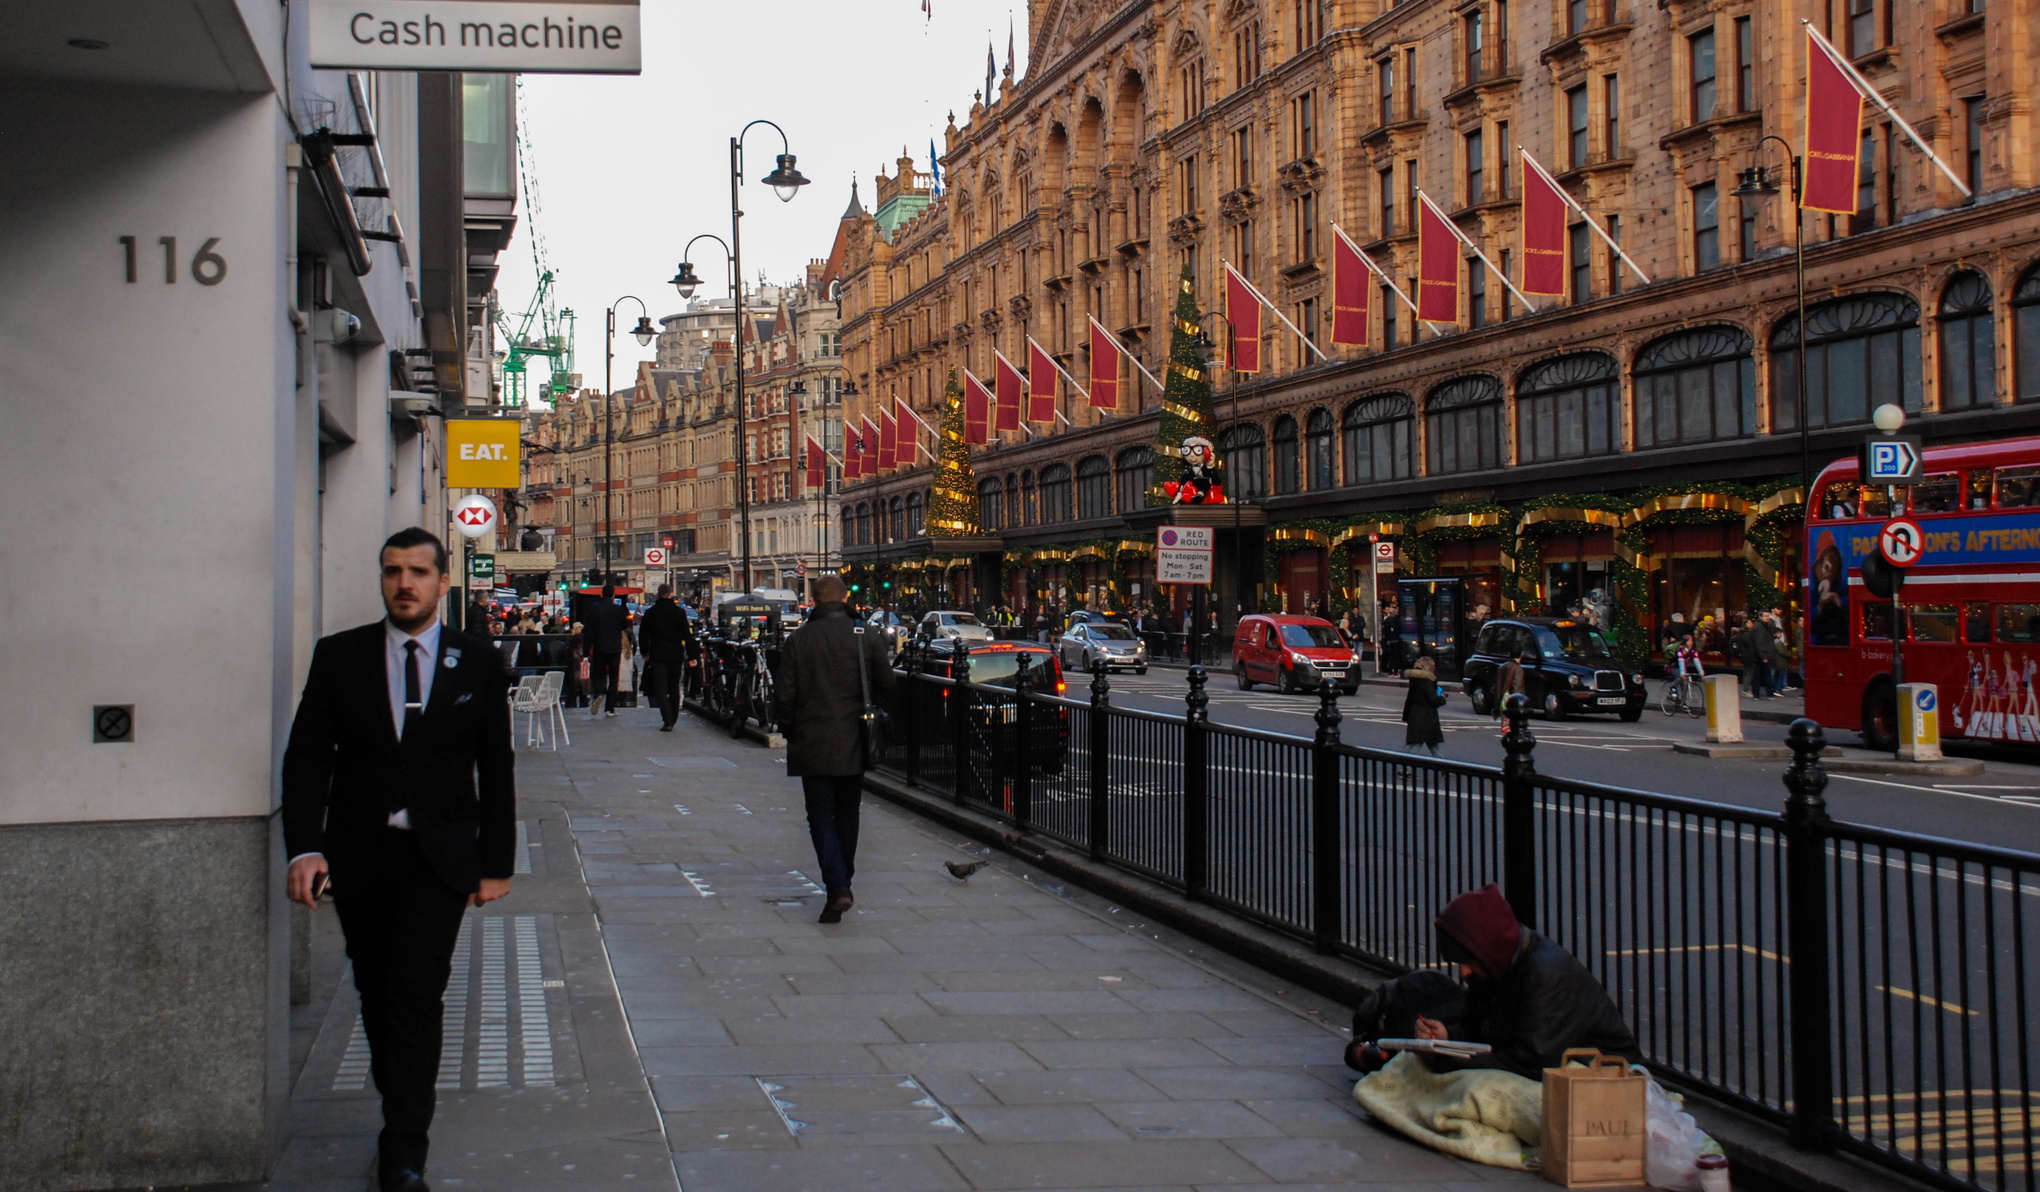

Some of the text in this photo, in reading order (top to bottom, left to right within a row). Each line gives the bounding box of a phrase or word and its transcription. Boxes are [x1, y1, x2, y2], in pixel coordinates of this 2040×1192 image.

[350, 12, 623, 50] Cash machine
[118, 235, 228, 286] 116
[459, 443, 509, 461] EAT.
[1876, 447, 1894, 472] P
[1175, 553, 1208, 561] stopping
[1586, 1120, 1631, 1135] PAUL
